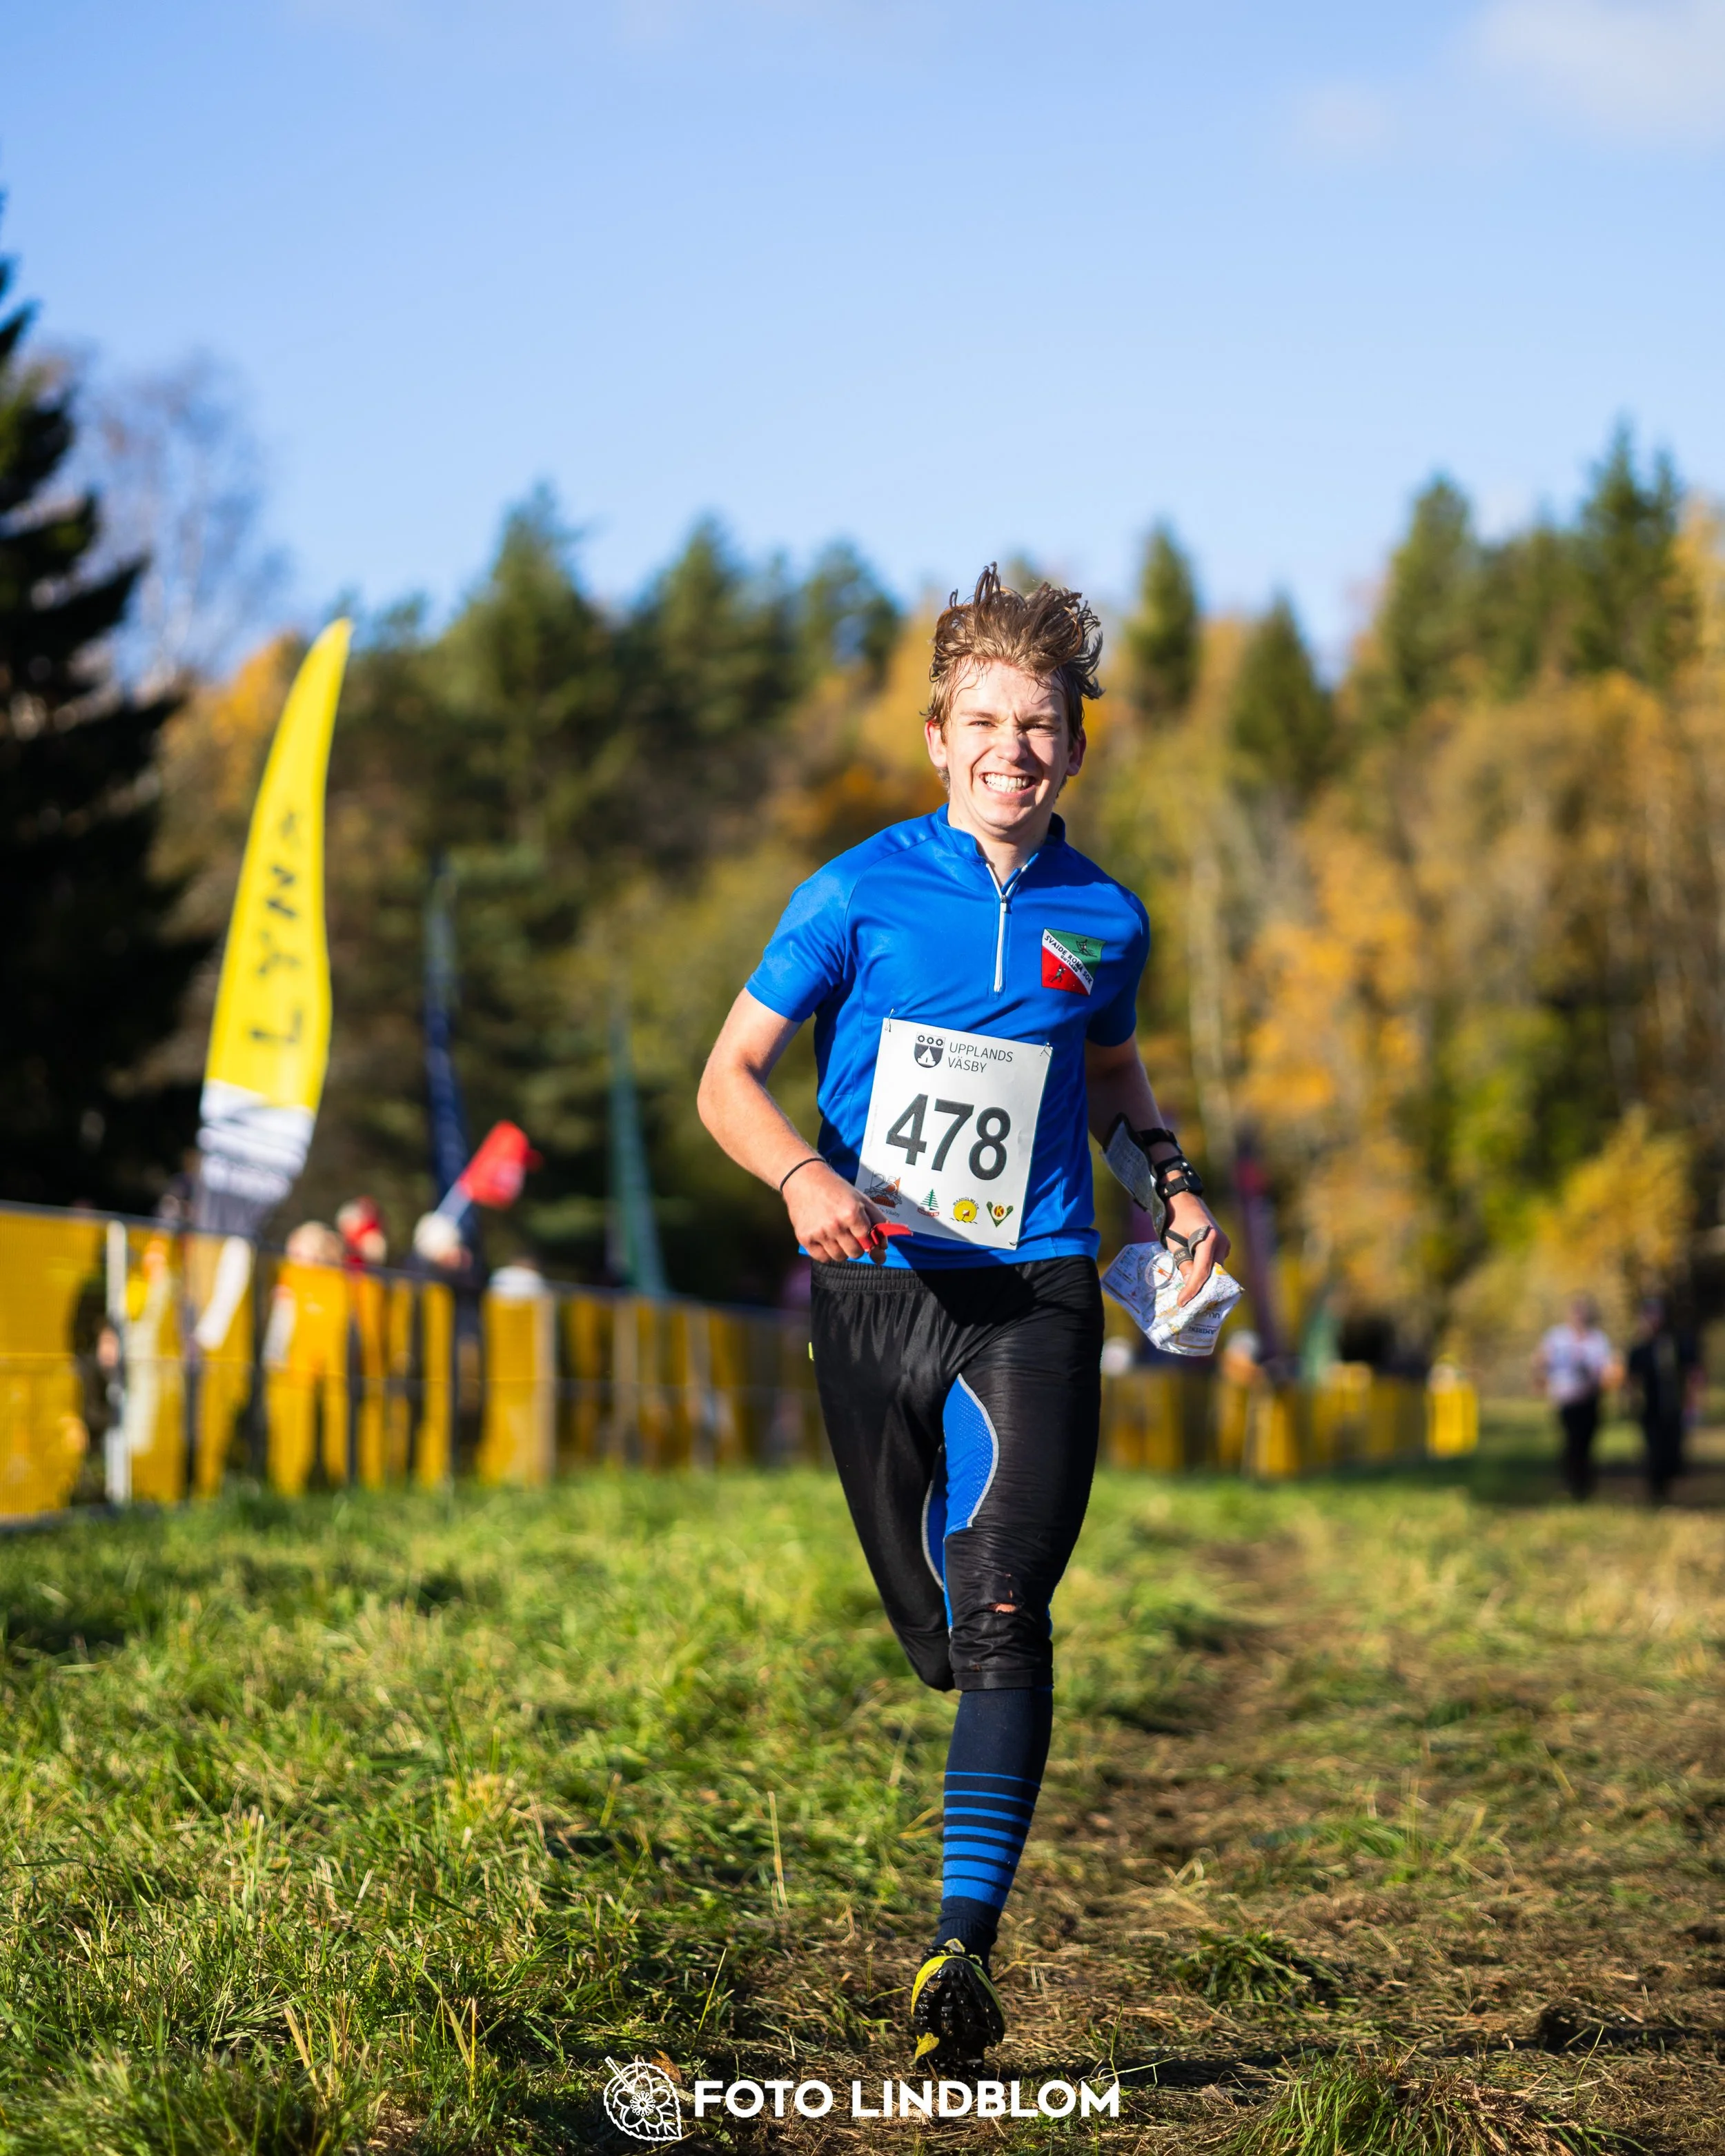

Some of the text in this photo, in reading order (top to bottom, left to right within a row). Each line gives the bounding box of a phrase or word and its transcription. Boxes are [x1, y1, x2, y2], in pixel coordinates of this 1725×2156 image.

[1044, 935, 1093, 985] SVAIDE ROMA SOK
[1061, 955, 1078, 973] GOTLAND
[949, 1041, 1014, 1063] UPPLANDS
[947, 1055, 987, 1074] VÄSBY
[885, 1093, 1012, 1181] 478
